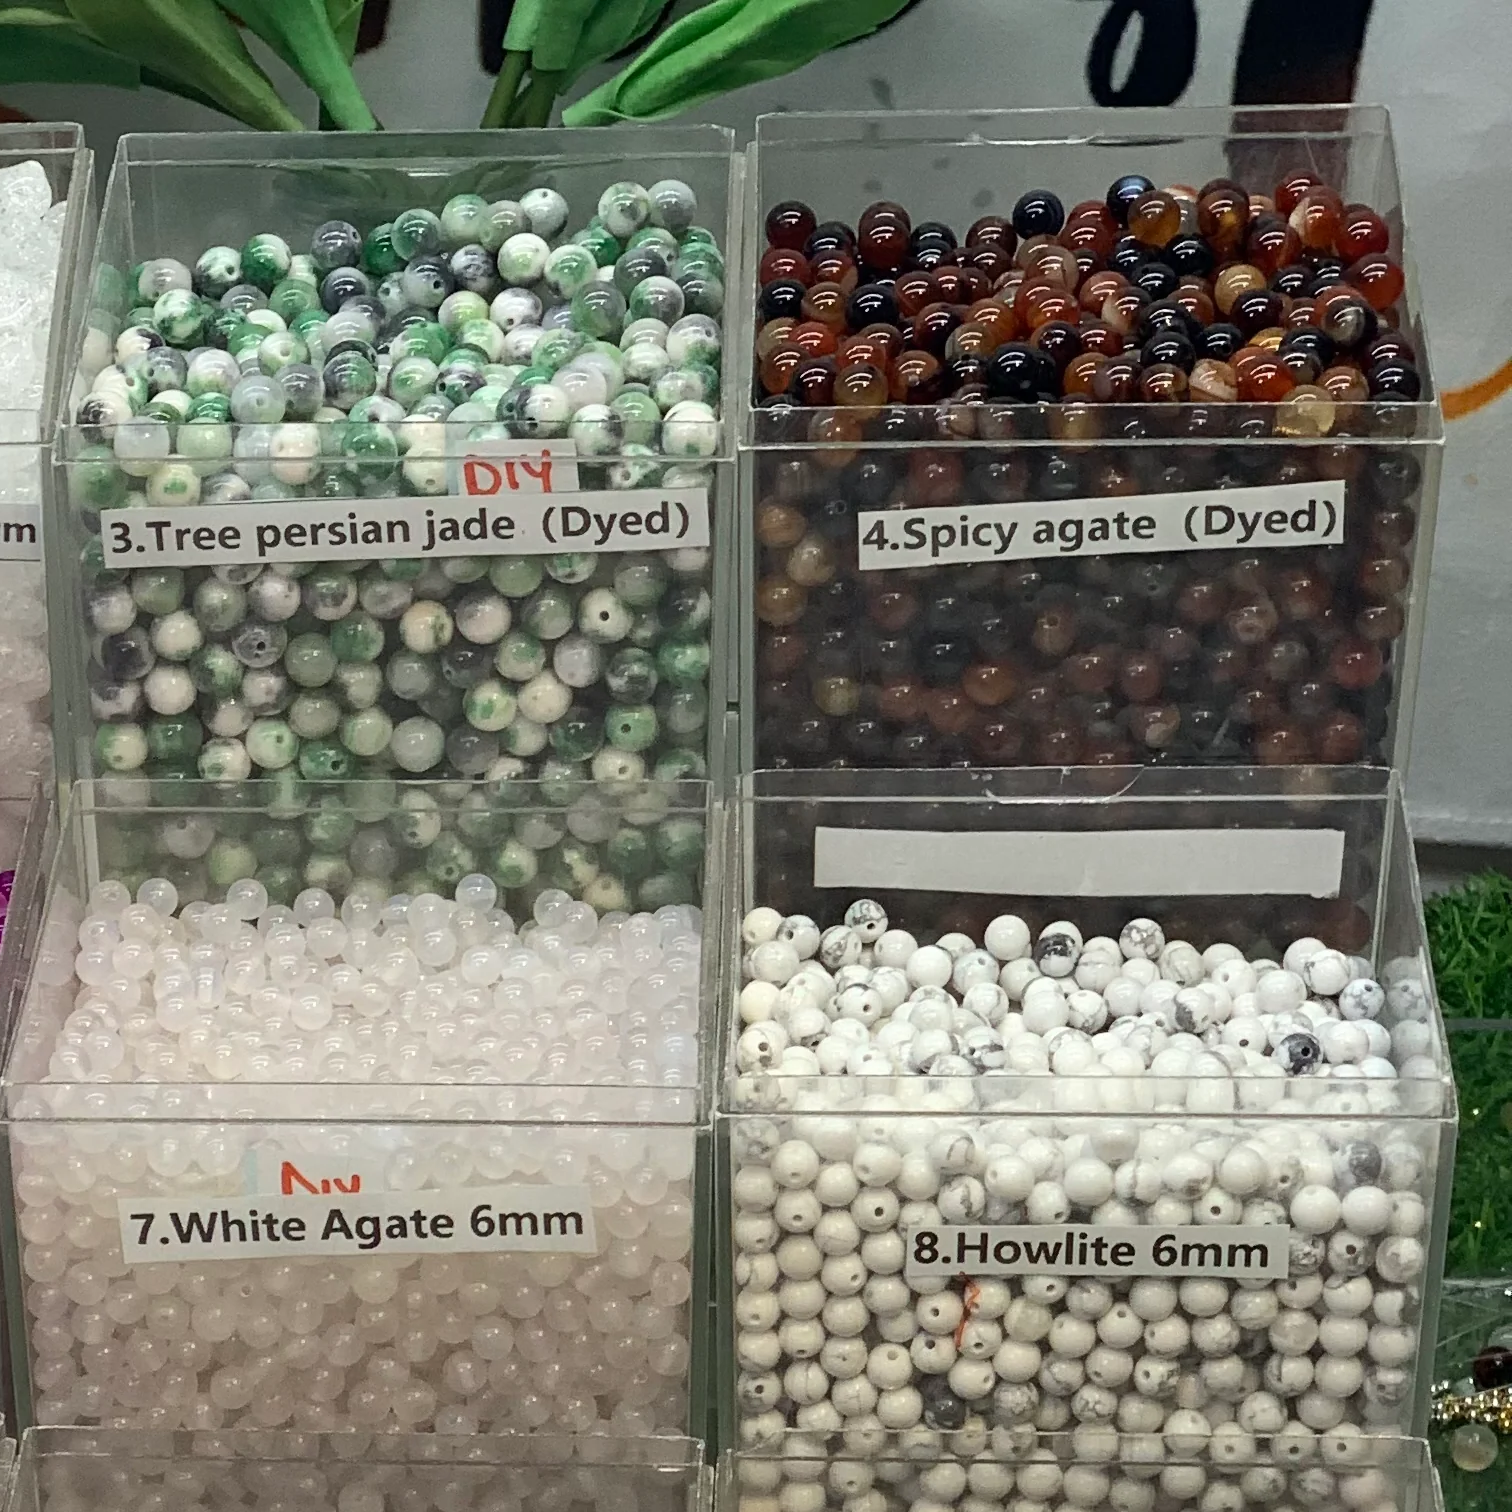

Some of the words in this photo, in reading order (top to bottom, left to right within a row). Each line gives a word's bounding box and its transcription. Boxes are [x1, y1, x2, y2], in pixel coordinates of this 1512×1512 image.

[463, 449, 553, 496] DIY
[109, 518, 241, 554] 3.Tree
[255, 511, 409, 556] persian
[422, 507, 516, 550] jade
[540, 500, 690, 544] (Dyed)
[861, 514, 1018, 557] 4.Spicy
[1031, 510, 1157, 552] agate
[1183, 500, 1338, 543] (Dyed)
[130, 1209, 307, 1246] 7.White
[320, 1206, 454, 1249] Agate
[470, 1204, 584, 1237] 6mm
[913, 1231, 1136, 1266] 8.Howlite
[1152, 1234, 1269, 1268] 6mm
